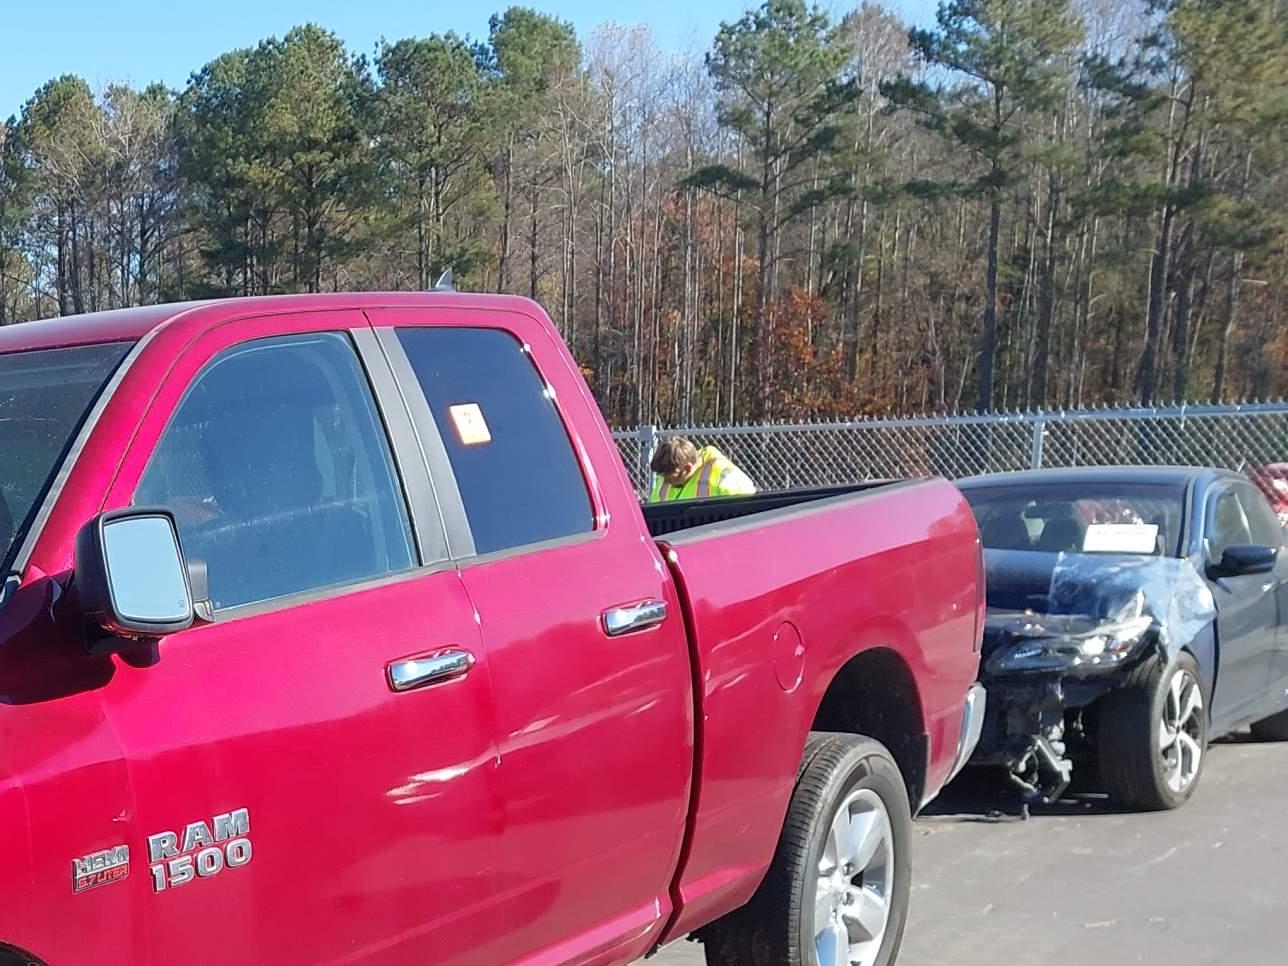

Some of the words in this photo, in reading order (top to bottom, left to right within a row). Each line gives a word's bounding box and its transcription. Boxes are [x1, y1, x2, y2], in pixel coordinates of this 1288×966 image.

[147, 807, 251, 864] RAM
[72, 844, 130, 877] HEMI
[77, 874, 97, 889] 5.7
[150, 838, 253, 894] 1500
